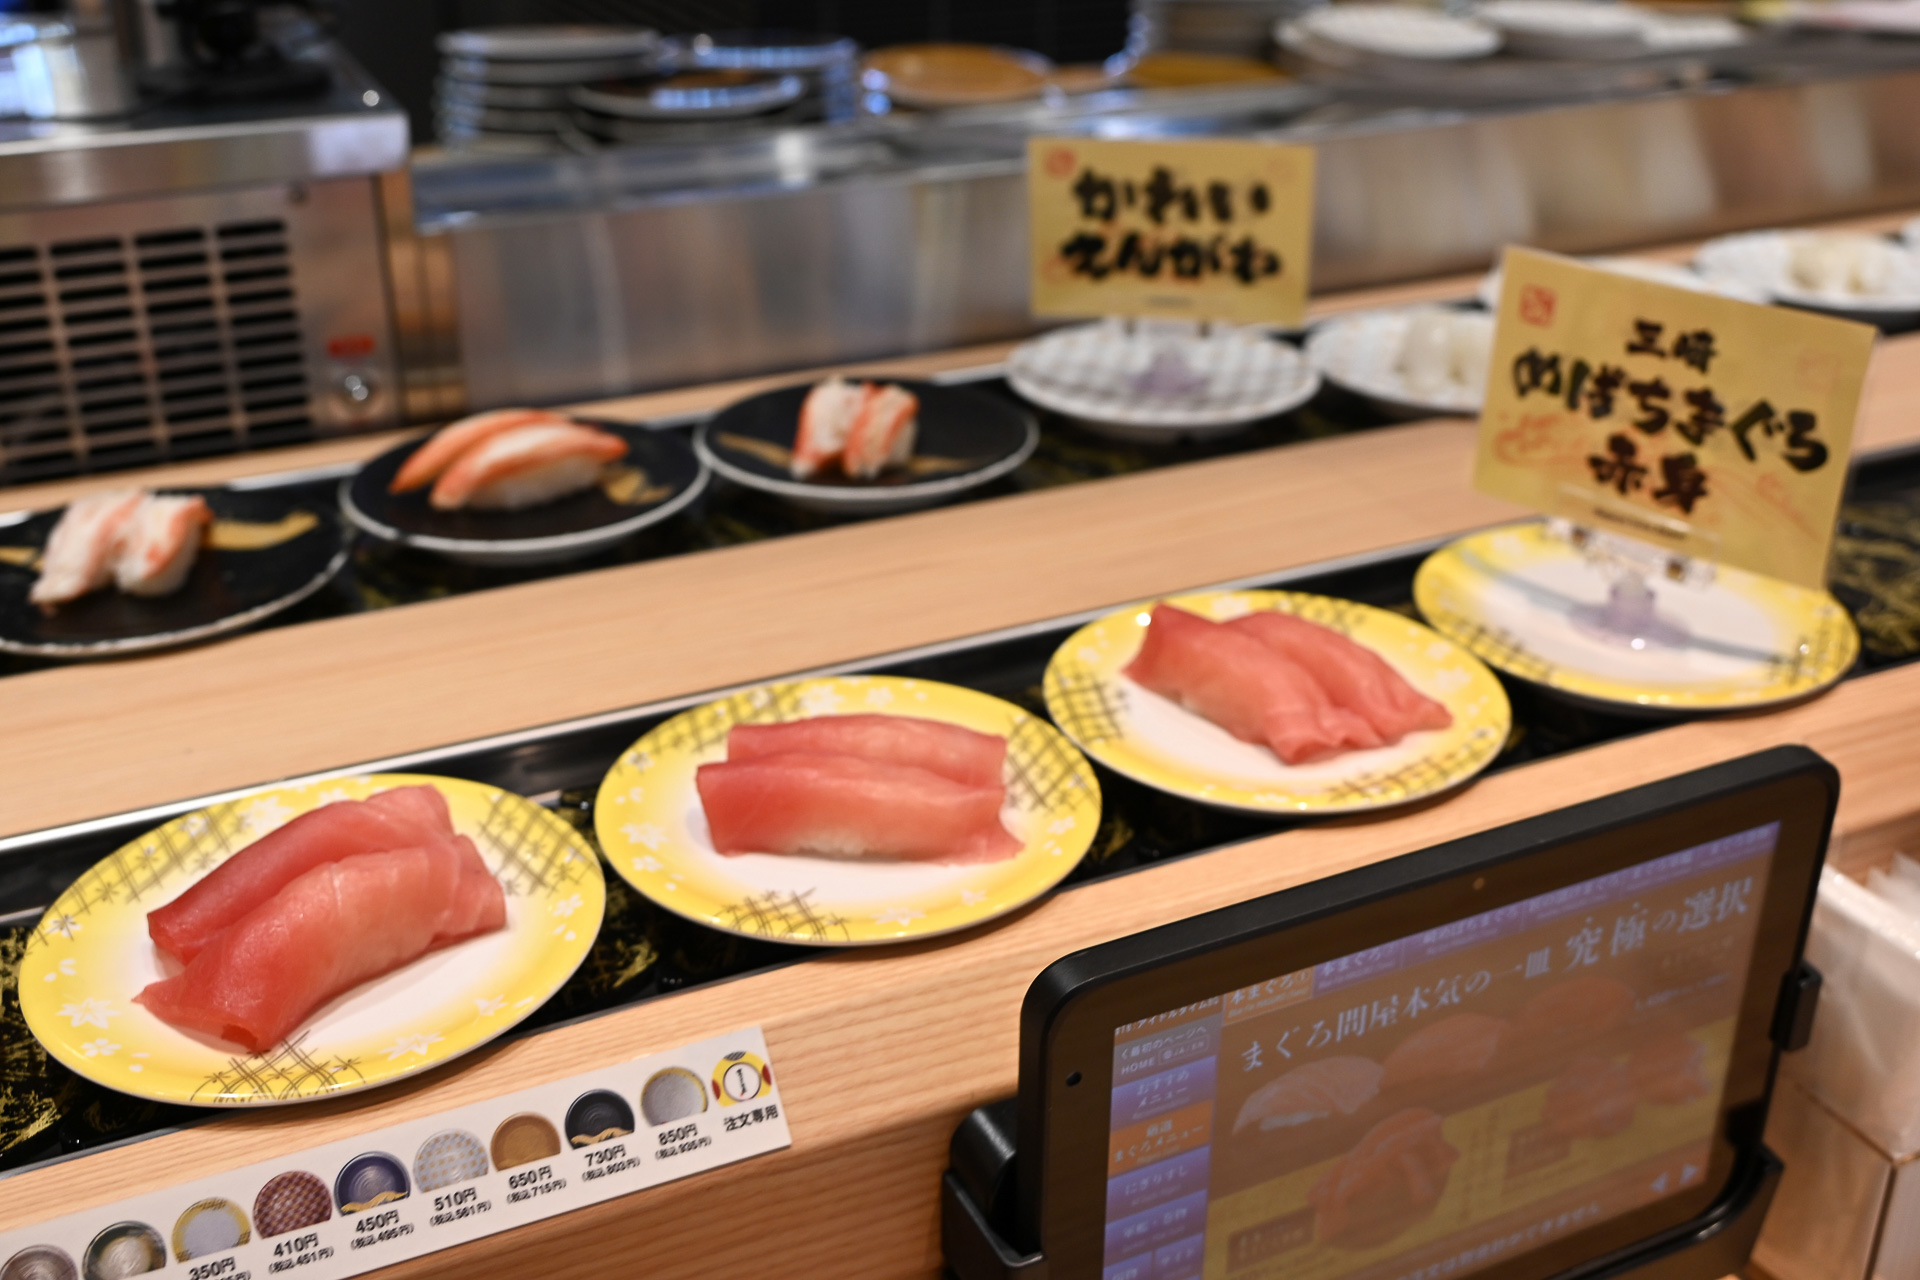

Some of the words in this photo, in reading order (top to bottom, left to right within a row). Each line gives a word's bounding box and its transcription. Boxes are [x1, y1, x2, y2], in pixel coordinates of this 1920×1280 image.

[1512, 346, 1828, 473] めばちまぐろ
[1587, 434, 1709, 515] 赤身
[1120, 1057, 1155, 1076] HOME
[723, 1104, 779, 1132] 注文専用
[658, 1123, 698, 1146] 850円
[584, 1143, 627, 1167] 730円
[508, 1165, 553, 1189] 650円
[433, 1187, 477, 1211] 510円
[355, 1209, 400, 1234] 450円
[273, 1232, 320, 1258] 410円
[189, 1256, 236, 1280] 350円
